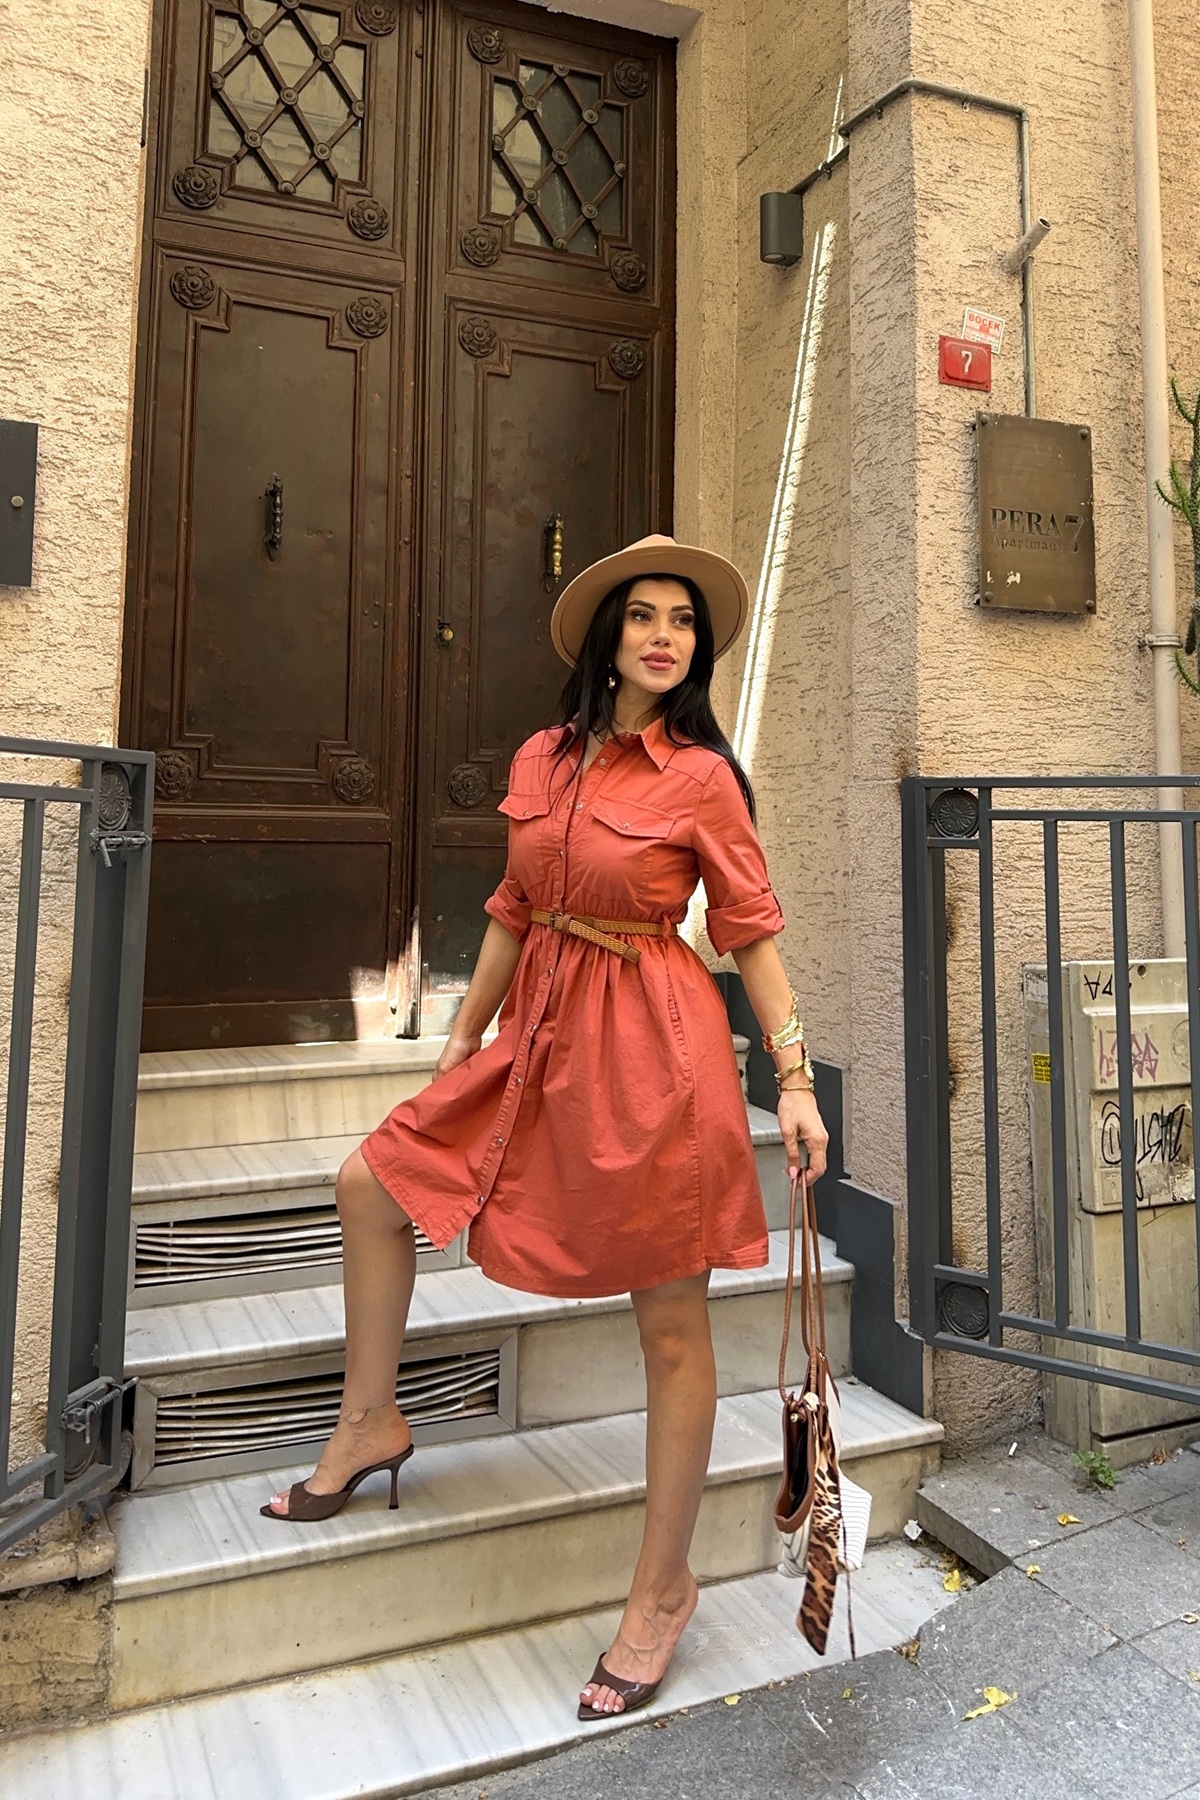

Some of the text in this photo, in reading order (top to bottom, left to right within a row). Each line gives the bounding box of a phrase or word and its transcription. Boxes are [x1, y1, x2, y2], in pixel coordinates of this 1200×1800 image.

[961, 350, 973, 375] 7
[989, 507, 1084, 553] PERA 7
